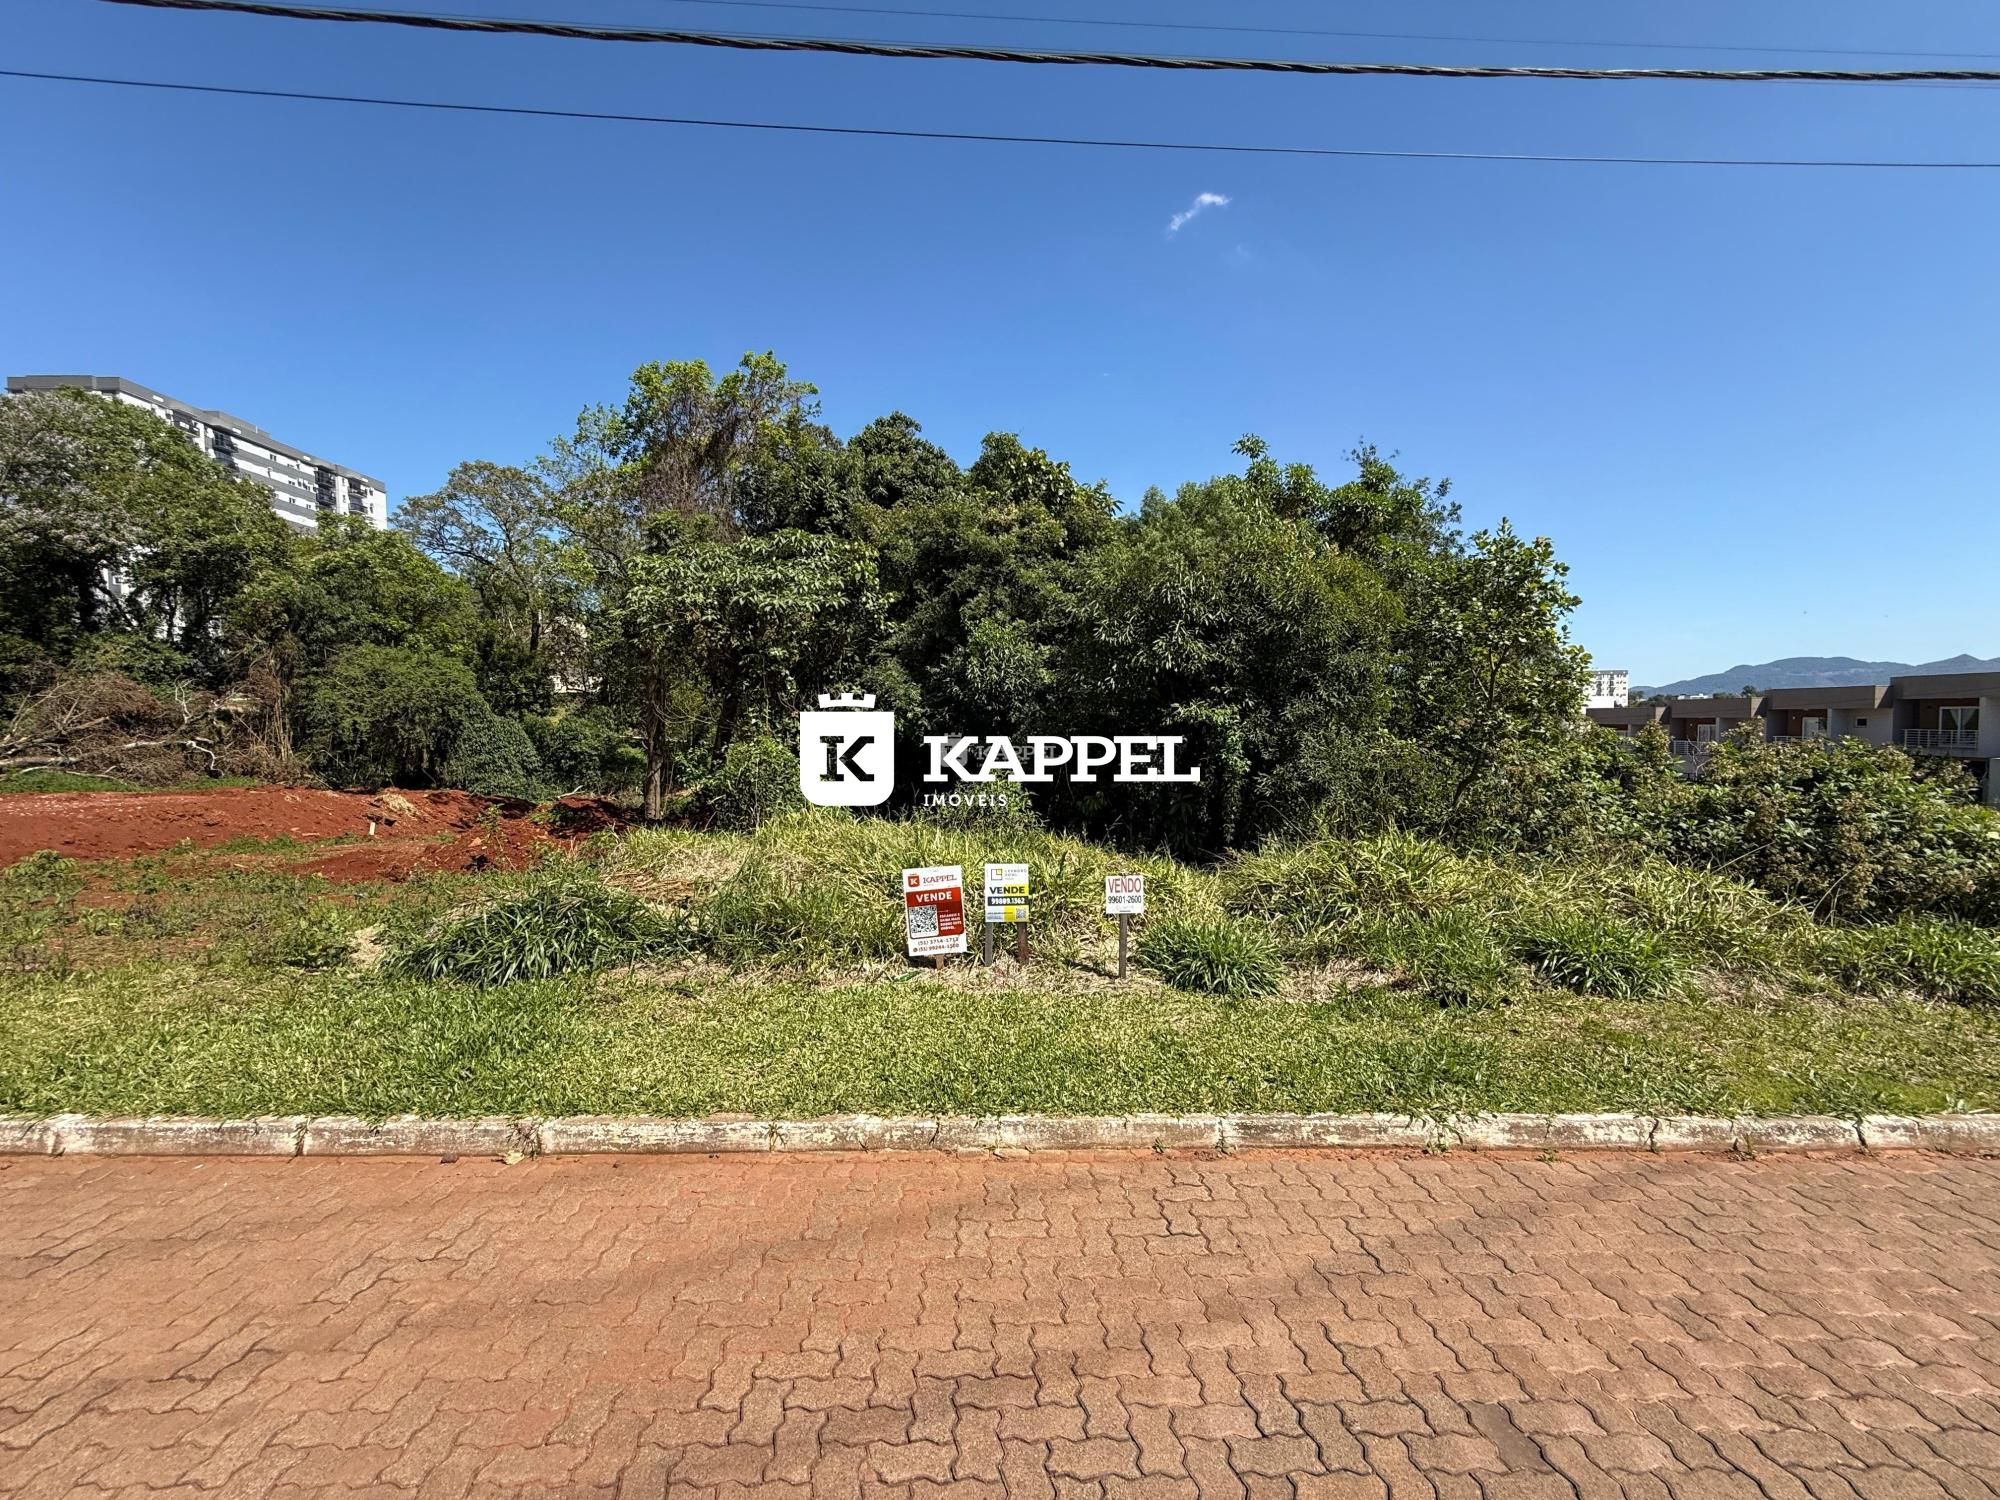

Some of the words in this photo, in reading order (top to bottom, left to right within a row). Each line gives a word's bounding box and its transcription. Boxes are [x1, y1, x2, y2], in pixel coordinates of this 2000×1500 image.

[922, 874, 957, 884] KAPPEL
[989, 886, 1026, 894] VENDE
[1108, 877, 1142, 893] VENDO
[915, 891, 953, 903] VENDE
